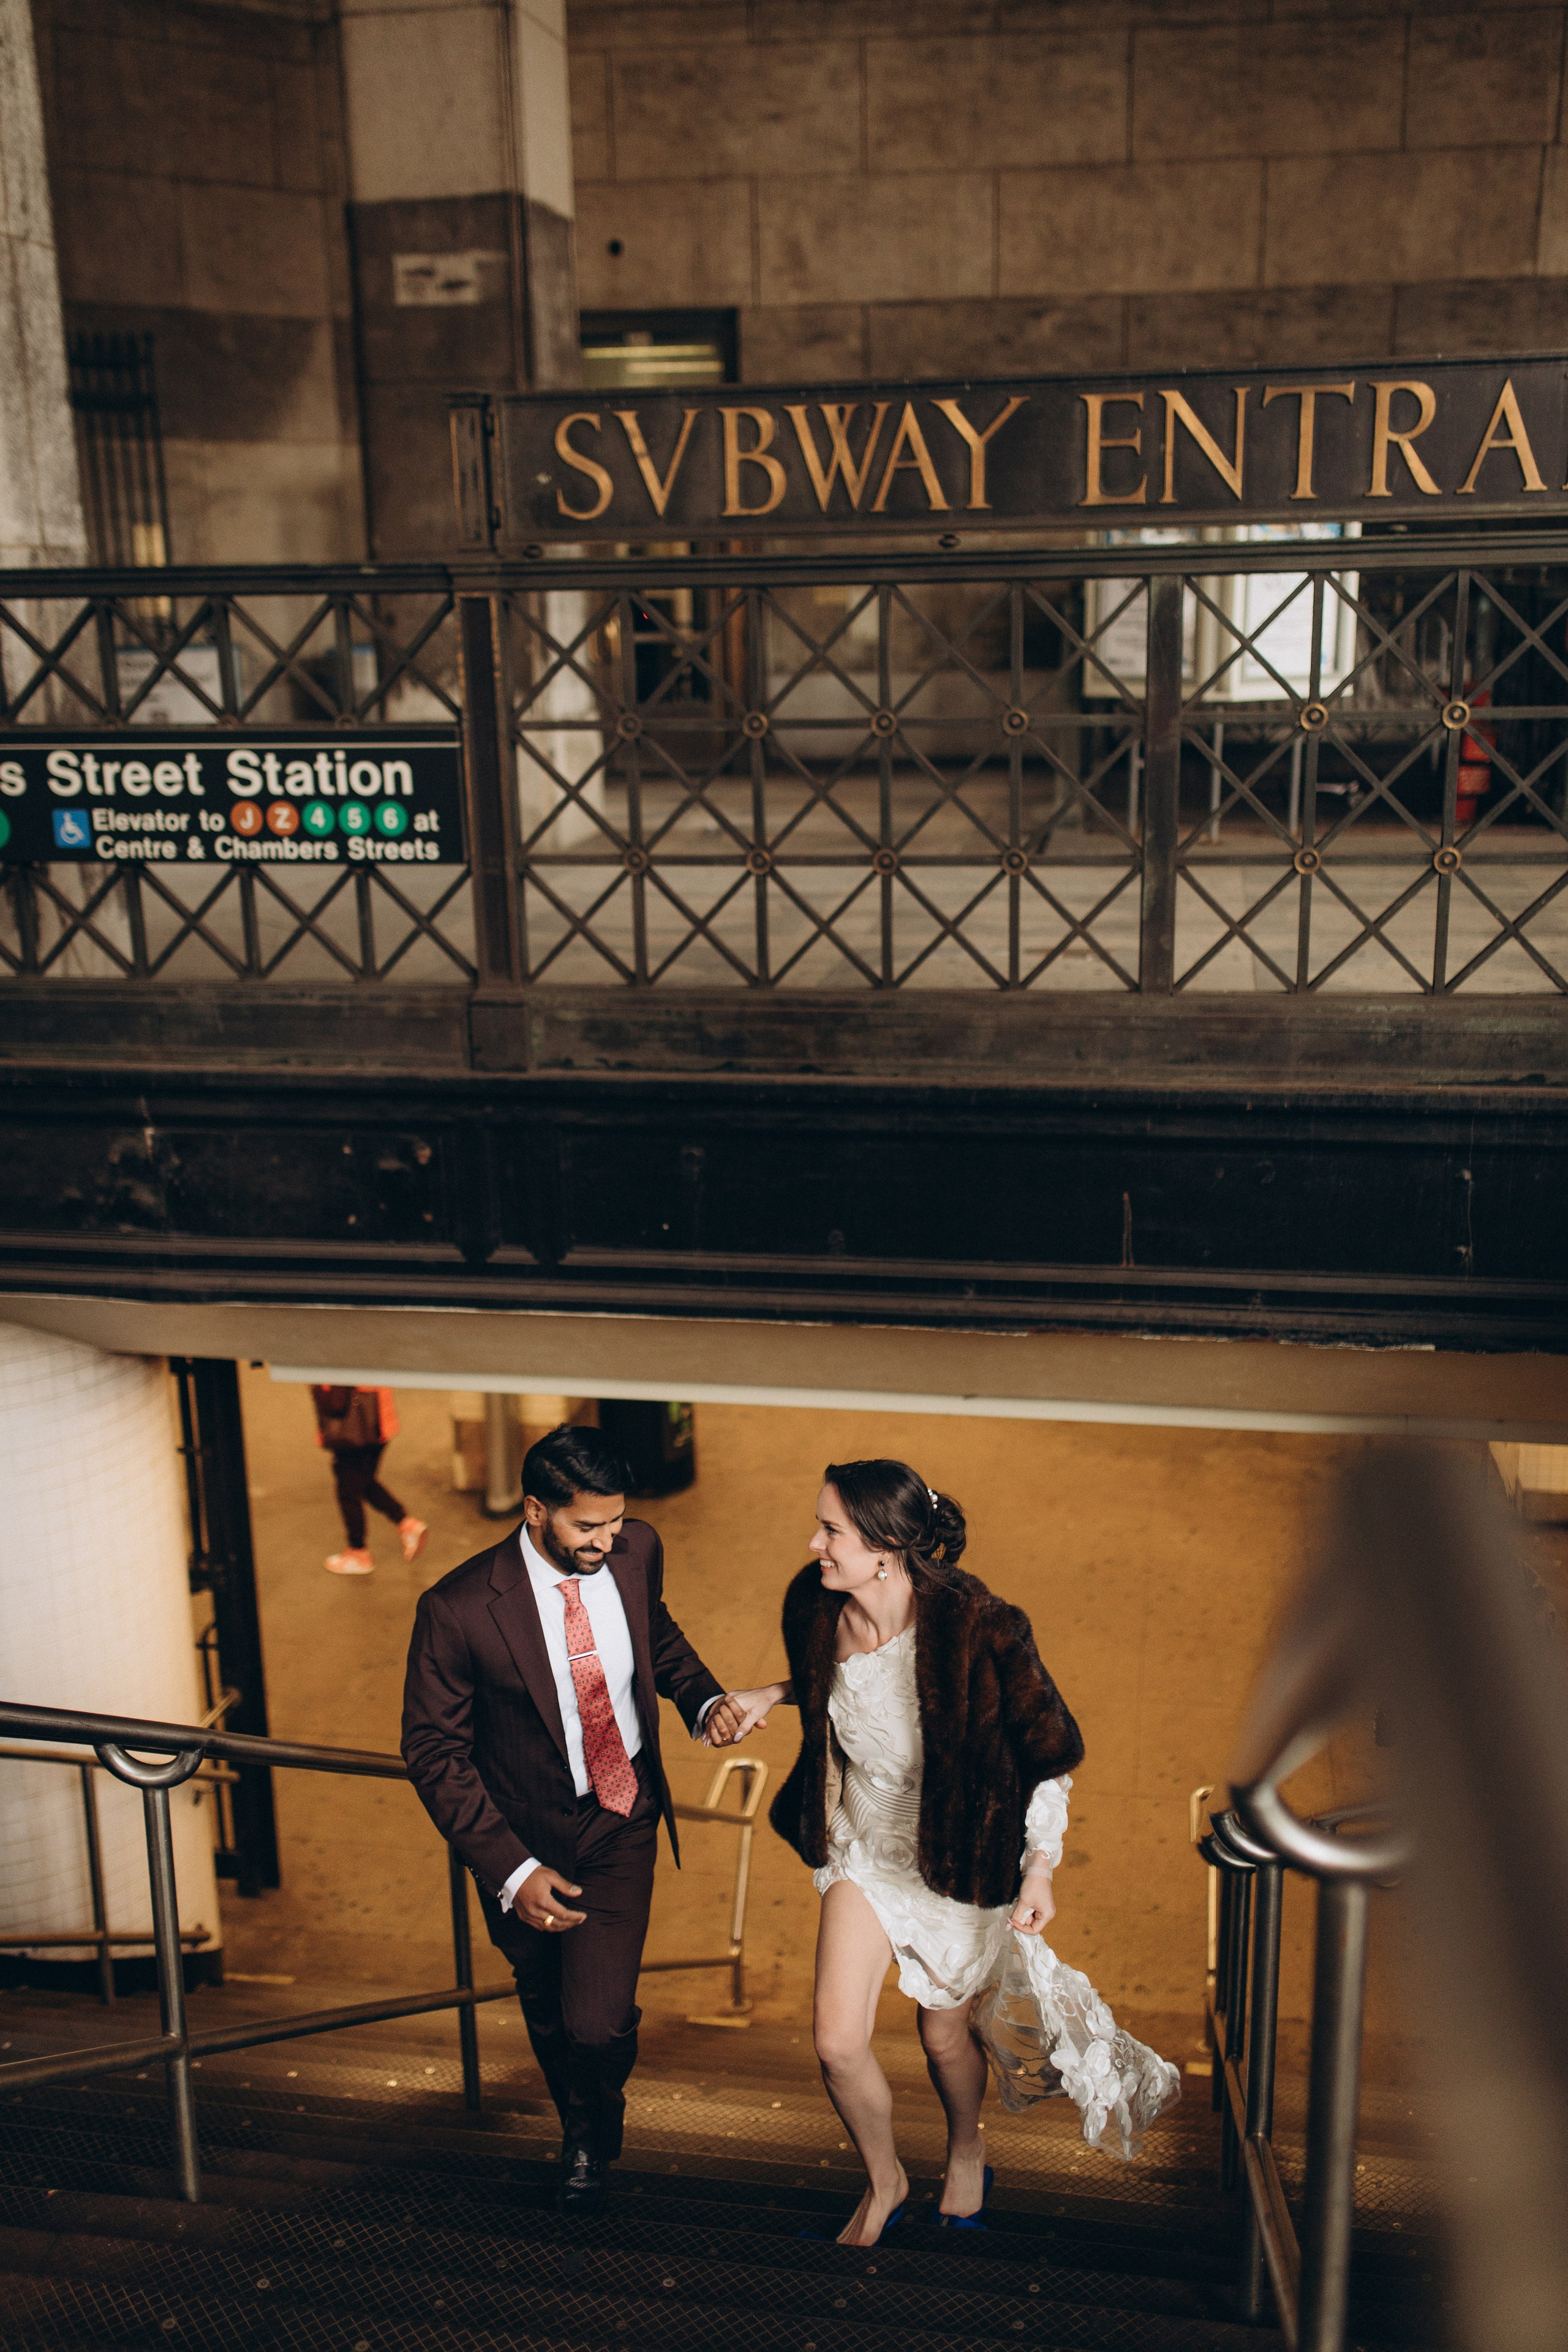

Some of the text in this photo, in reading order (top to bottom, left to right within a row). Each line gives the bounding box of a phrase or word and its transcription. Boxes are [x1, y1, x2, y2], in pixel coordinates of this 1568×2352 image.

[554, 377, 1568, 521] SVBWAY ENTRA
[46, 750, 205, 797] Street
[226, 749, 414, 797] Station
[92, 807, 190, 832] Elevator
[198, 809, 227, 832] to
[413, 809, 440, 832] at
[96, 835, 440, 861] Centre & Chambers Streets
